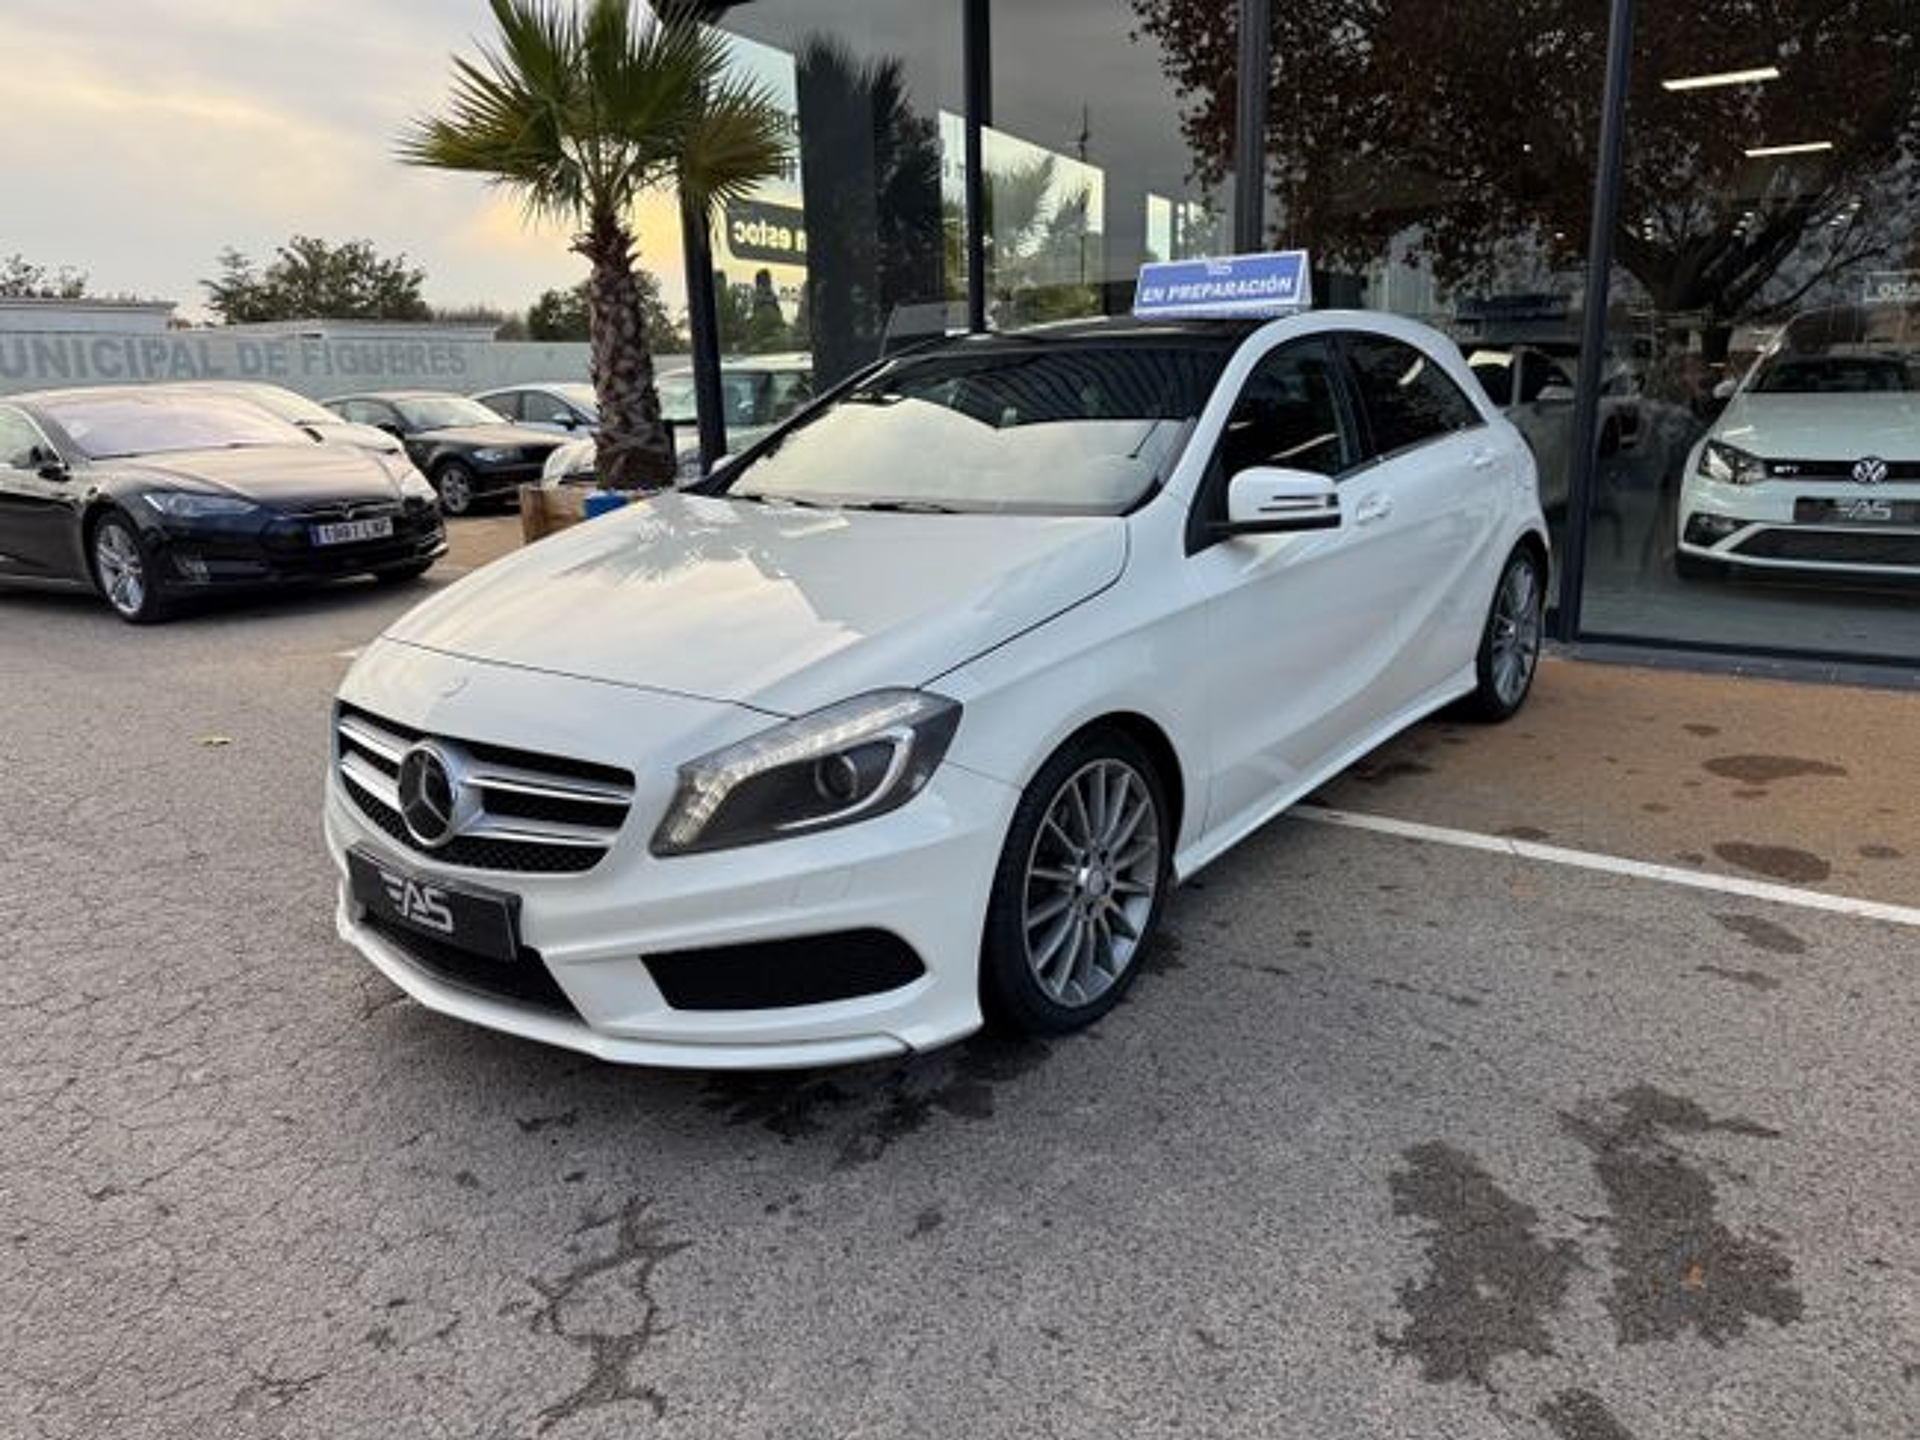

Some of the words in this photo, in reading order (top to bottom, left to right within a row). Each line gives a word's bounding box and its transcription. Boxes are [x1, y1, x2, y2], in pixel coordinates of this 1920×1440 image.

[1142, 286, 1165, 303] EN
[1167, 275, 1293, 301] PREPARACIÓN
[236, 341, 288, 377] DE
[302, 340, 468, 376] FIGUERES
